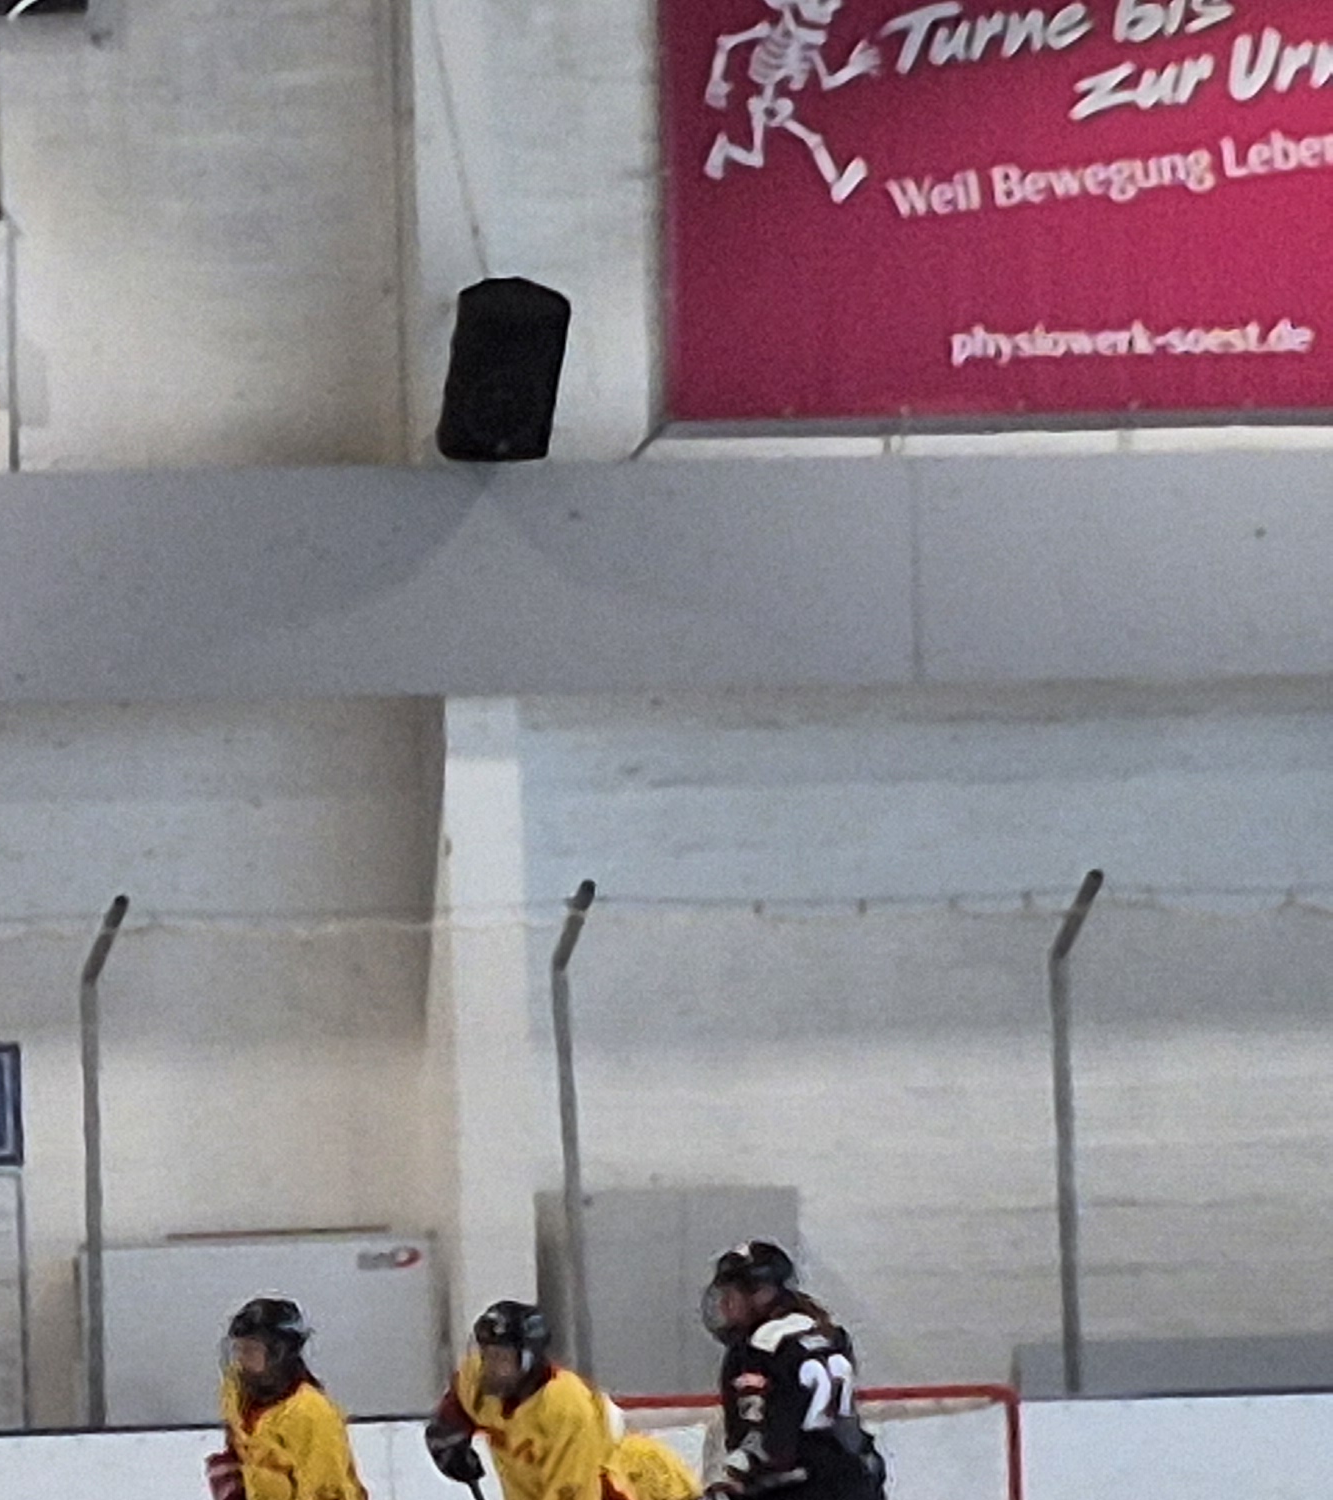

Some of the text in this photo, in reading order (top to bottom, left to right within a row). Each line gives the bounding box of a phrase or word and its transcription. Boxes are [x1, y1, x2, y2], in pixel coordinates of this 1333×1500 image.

[880, 0, 1235, 74] Turne bis
[885, 168, 982, 219] Weil
[991, 147, 1216, 208] Bewegung
